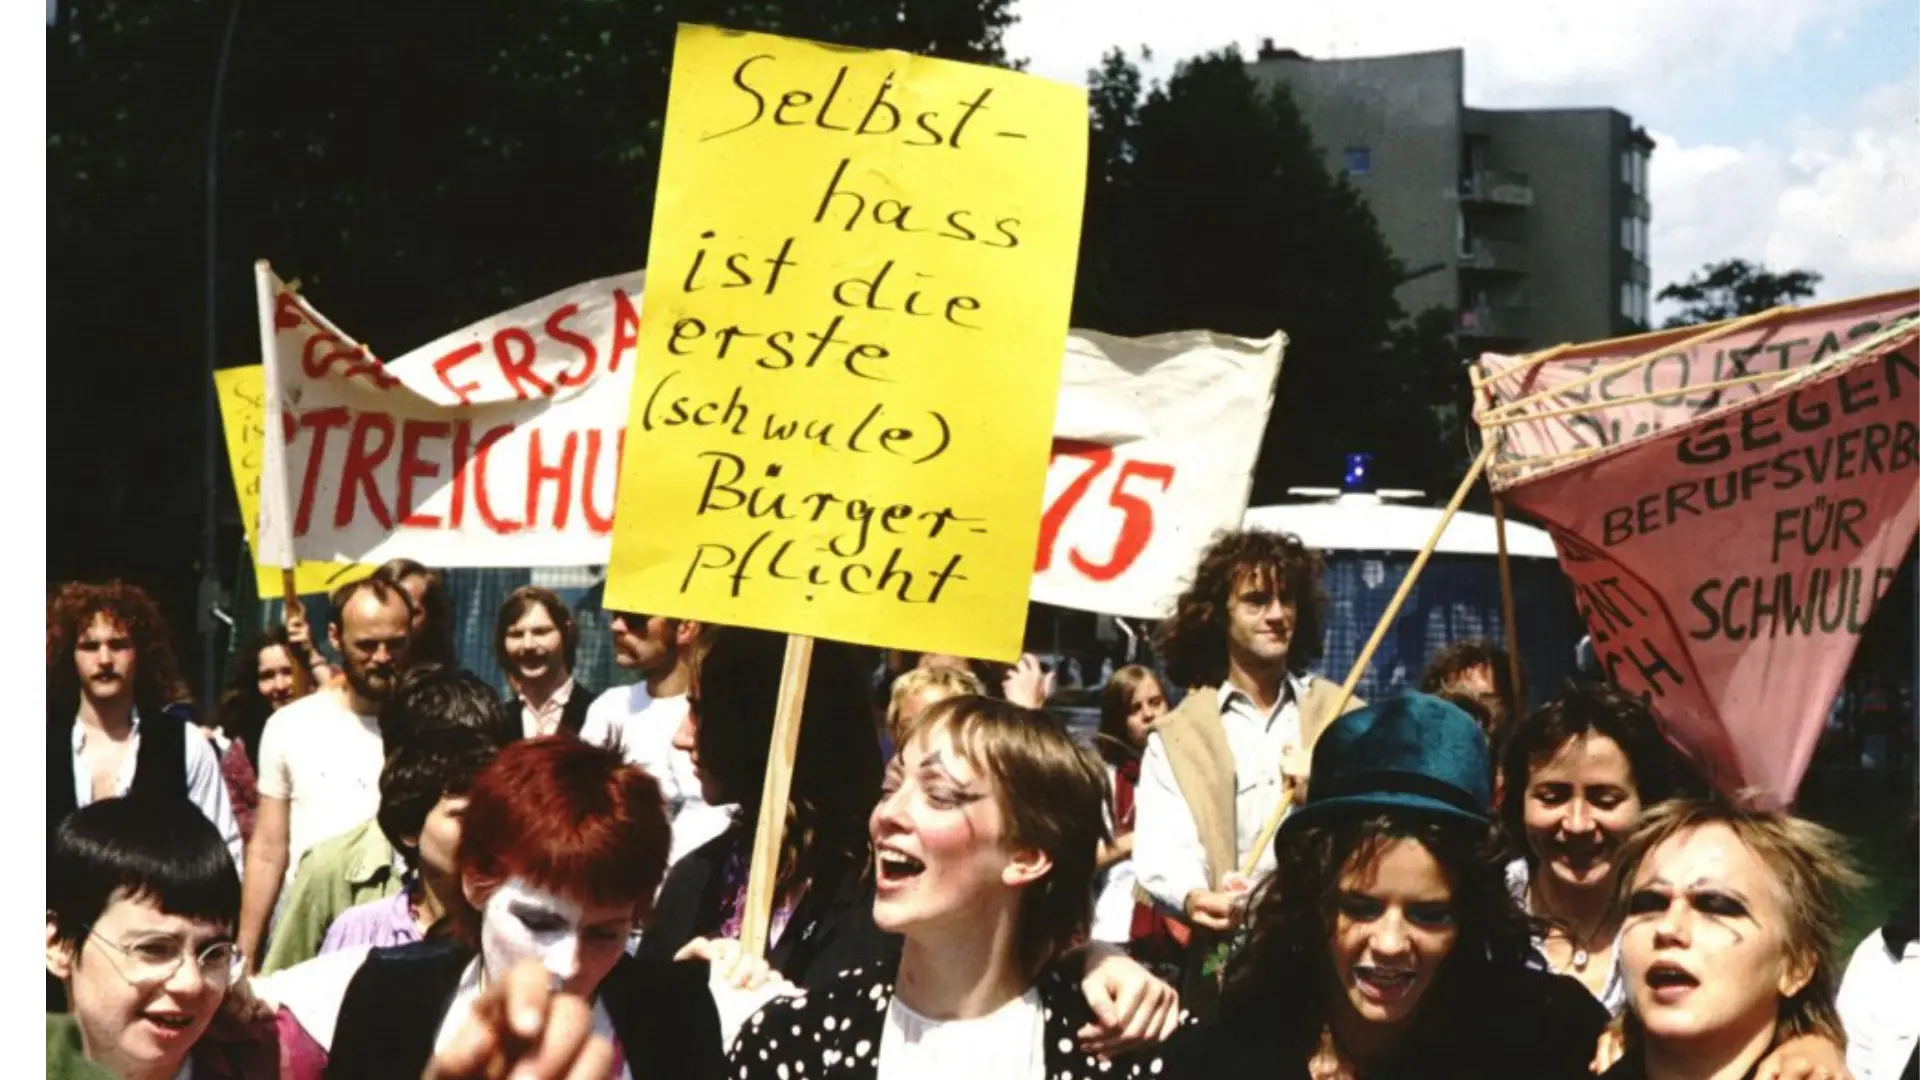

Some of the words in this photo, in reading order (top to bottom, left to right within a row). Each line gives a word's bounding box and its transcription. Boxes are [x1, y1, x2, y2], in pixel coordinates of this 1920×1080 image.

[699, 54, 1027, 149] Selbst-
[814, 158, 1021, 249] hass
[683, 231, 797, 295] ist
[833, 260, 984, 329] die
[667, 315, 897, 382] erste
[642, 371, 951, 464] (schwule)
[281, 405, 627, 538] TREICHU
[697, 452, 988, 558] Bürger-
[1771, 494, 1868, 564] FÜR
